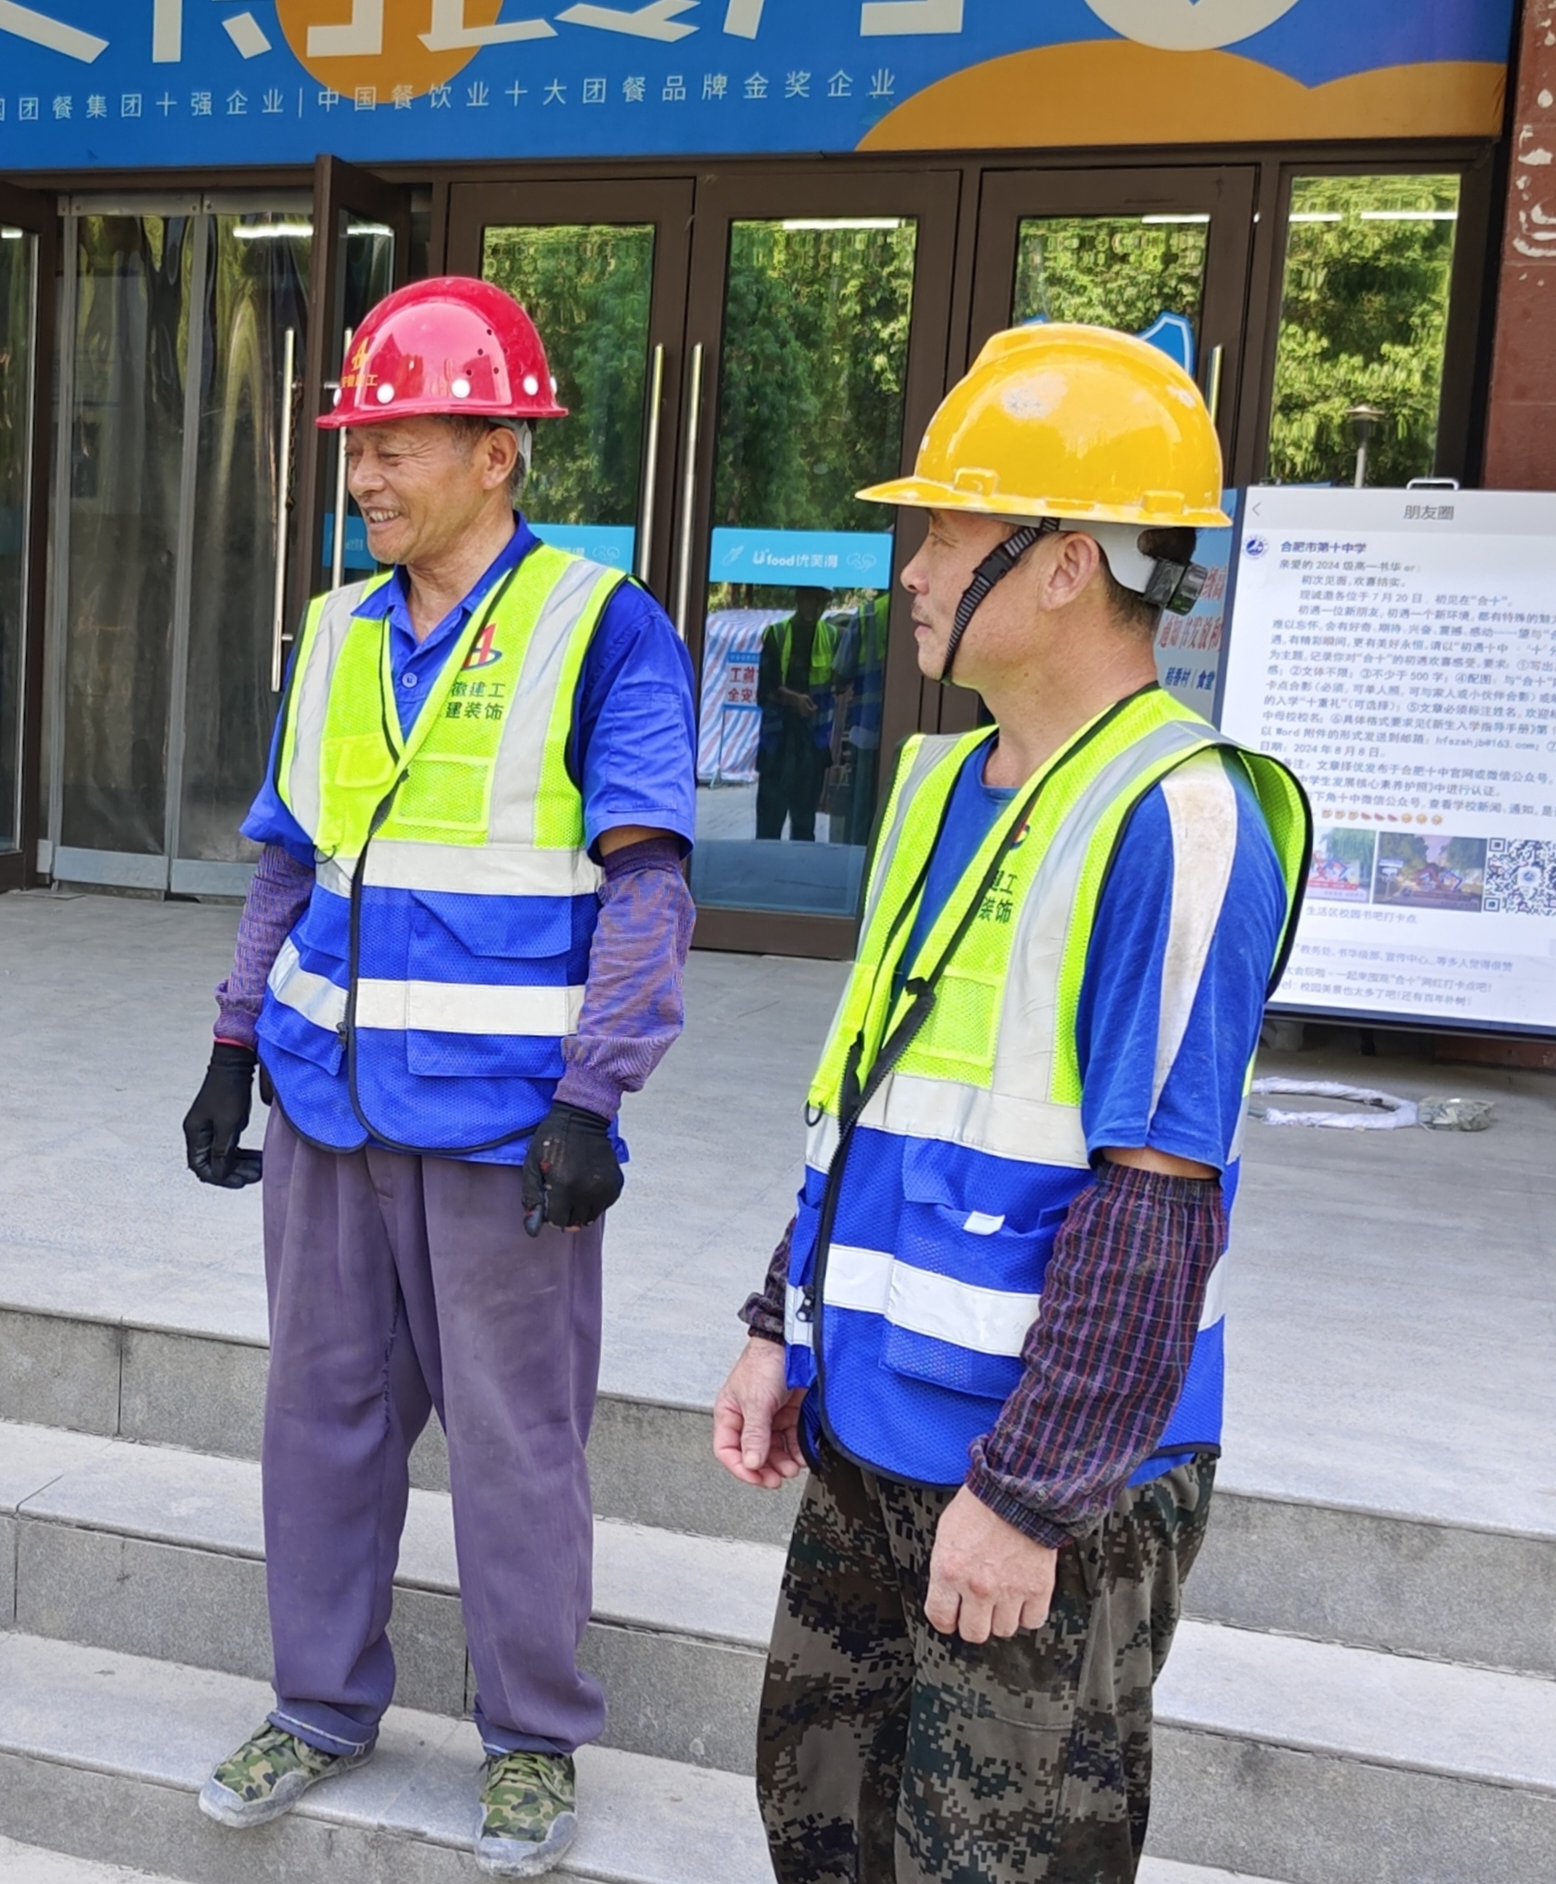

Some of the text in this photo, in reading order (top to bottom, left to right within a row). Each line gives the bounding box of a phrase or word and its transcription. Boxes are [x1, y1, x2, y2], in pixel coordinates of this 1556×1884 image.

[317, 69, 896, 113] 中国餐饮业十大团餐品牌金奖企业
[1403, 504, 1455, 521] 朋友圈
[1280, 541, 1367, 554] 合肥市第十中学
[1316, 560, 1340, 570] 2024
[1372, 592, 1380, 602] 7
[1381, 592, 1393, 604] 月
[1395, 593, 1409, 602] 20
[1410, 671, 1429, 681] 500
[445, 701, 504, 720] 建装饰
[1261, 726, 1272, 736] 以
[1275, 727, 1300, 738] Word
[1320, 743, 1332, 754] 年
[1334, 746, 1342, 755] 8
[1344, 745, 1356, 757] 月
[1358, 747, 1366, 757] 8
